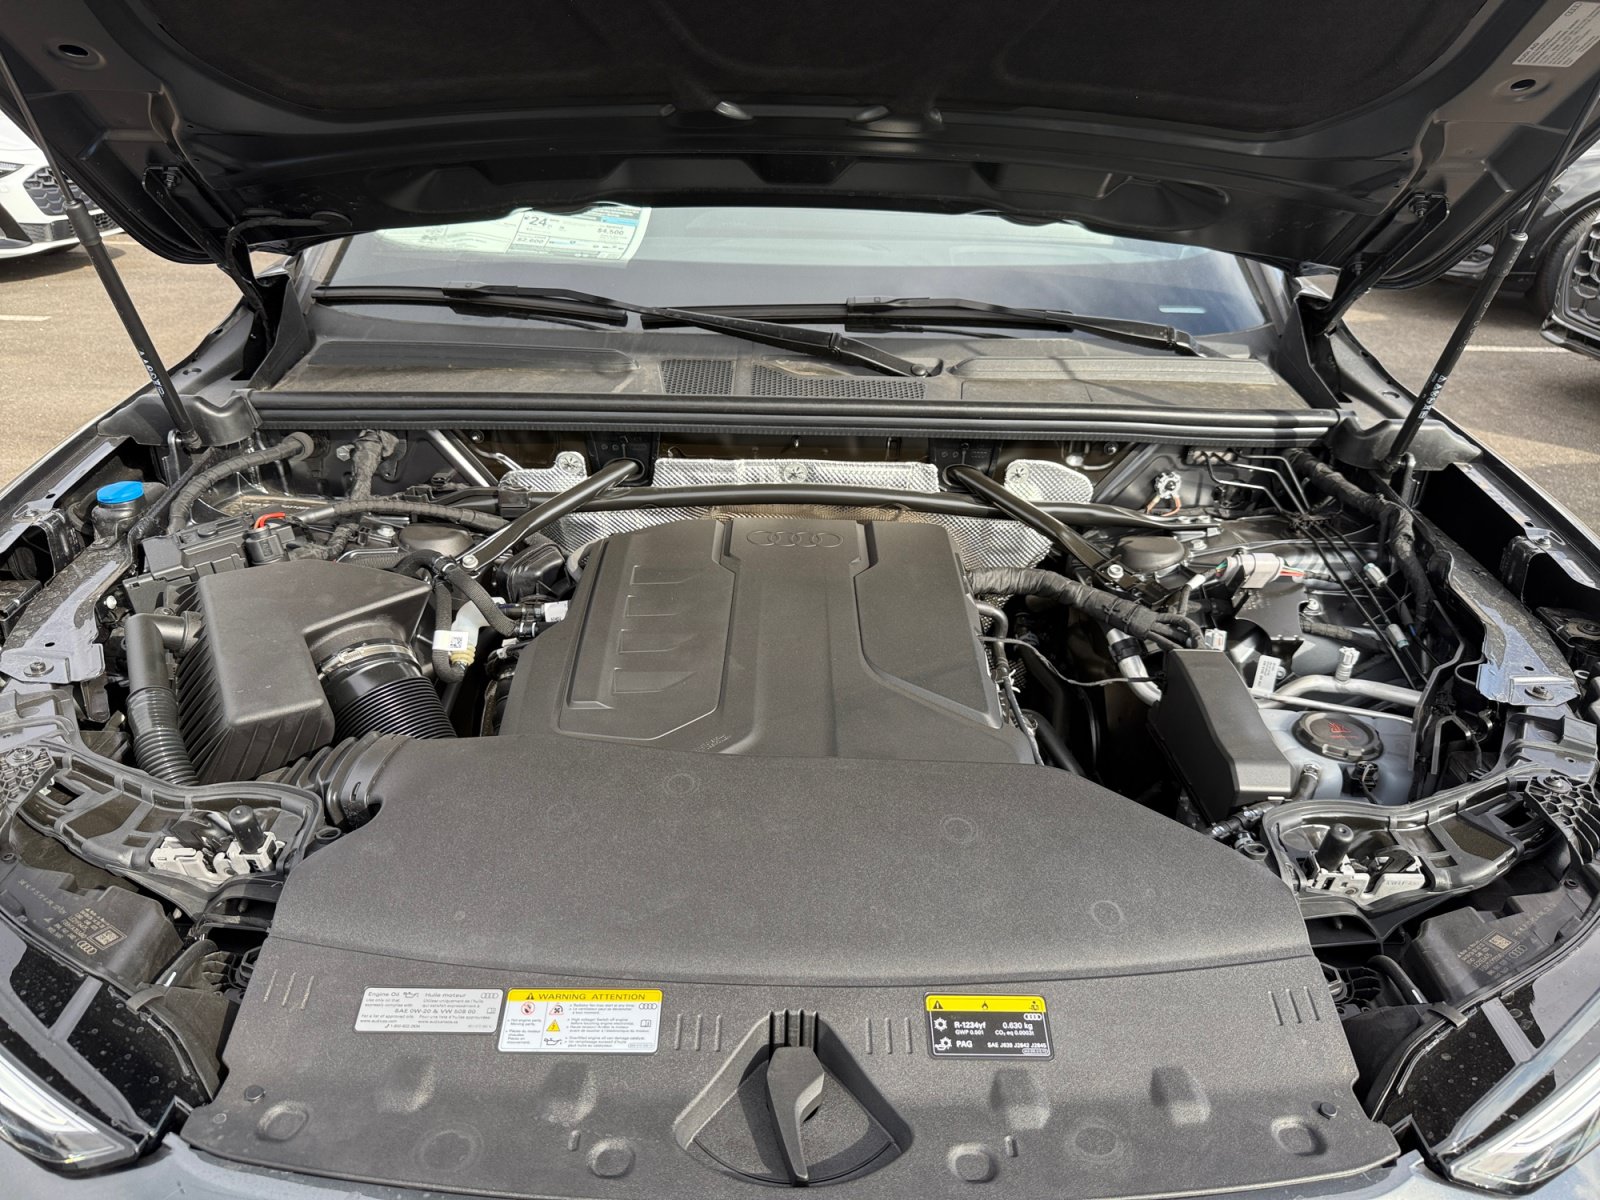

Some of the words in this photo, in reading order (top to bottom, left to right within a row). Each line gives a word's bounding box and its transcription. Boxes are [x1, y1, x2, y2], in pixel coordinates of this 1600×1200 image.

[529, 216, 547, 227] 24
[954, 1021, 986, 1030] R-1234yf
[1024, 1022, 1033, 1030] kg
